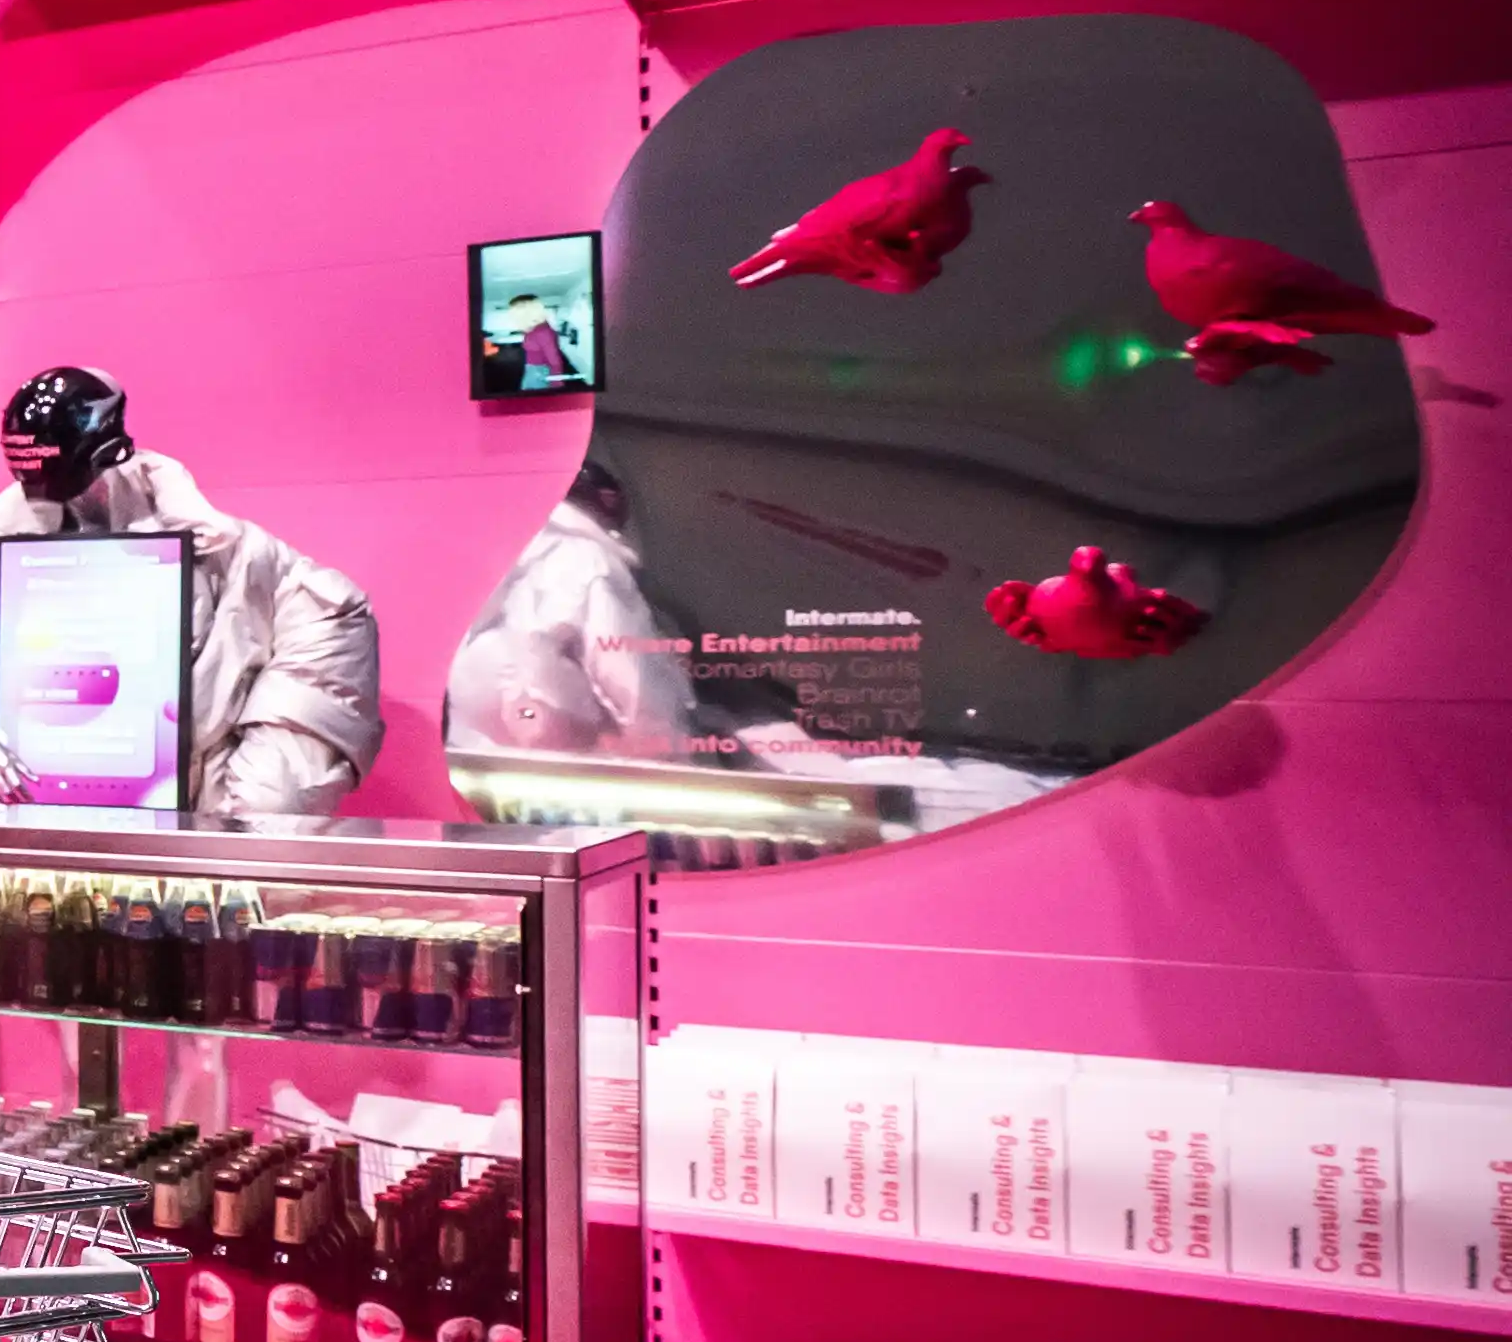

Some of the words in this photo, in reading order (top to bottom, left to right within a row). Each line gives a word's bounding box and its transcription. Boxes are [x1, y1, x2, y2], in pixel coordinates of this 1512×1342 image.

[700, 632, 923, 653] Entertainment
[844, 1120, 870, 1218] Consulting
[879, 1104, 904, 1177] Insights
[1028, 1118, 1055, 1191] Insights
[1186, 1132, 1215, 1208] Insights
[879, 1181, 899, 1222] Data
[991, 1134, 1018, 1236] Consulting
[1028, 1194, 1050, 1240] Data
[1146, 1150, 1176, 1255] Consulting
[1314, 1164, 1343, 1272] Consulting
[1355, 1146, 1386, 1224] Insights
[1186, 1214, 1211, 1258] Data
[1355, 1229, 1382, 1278] Data
